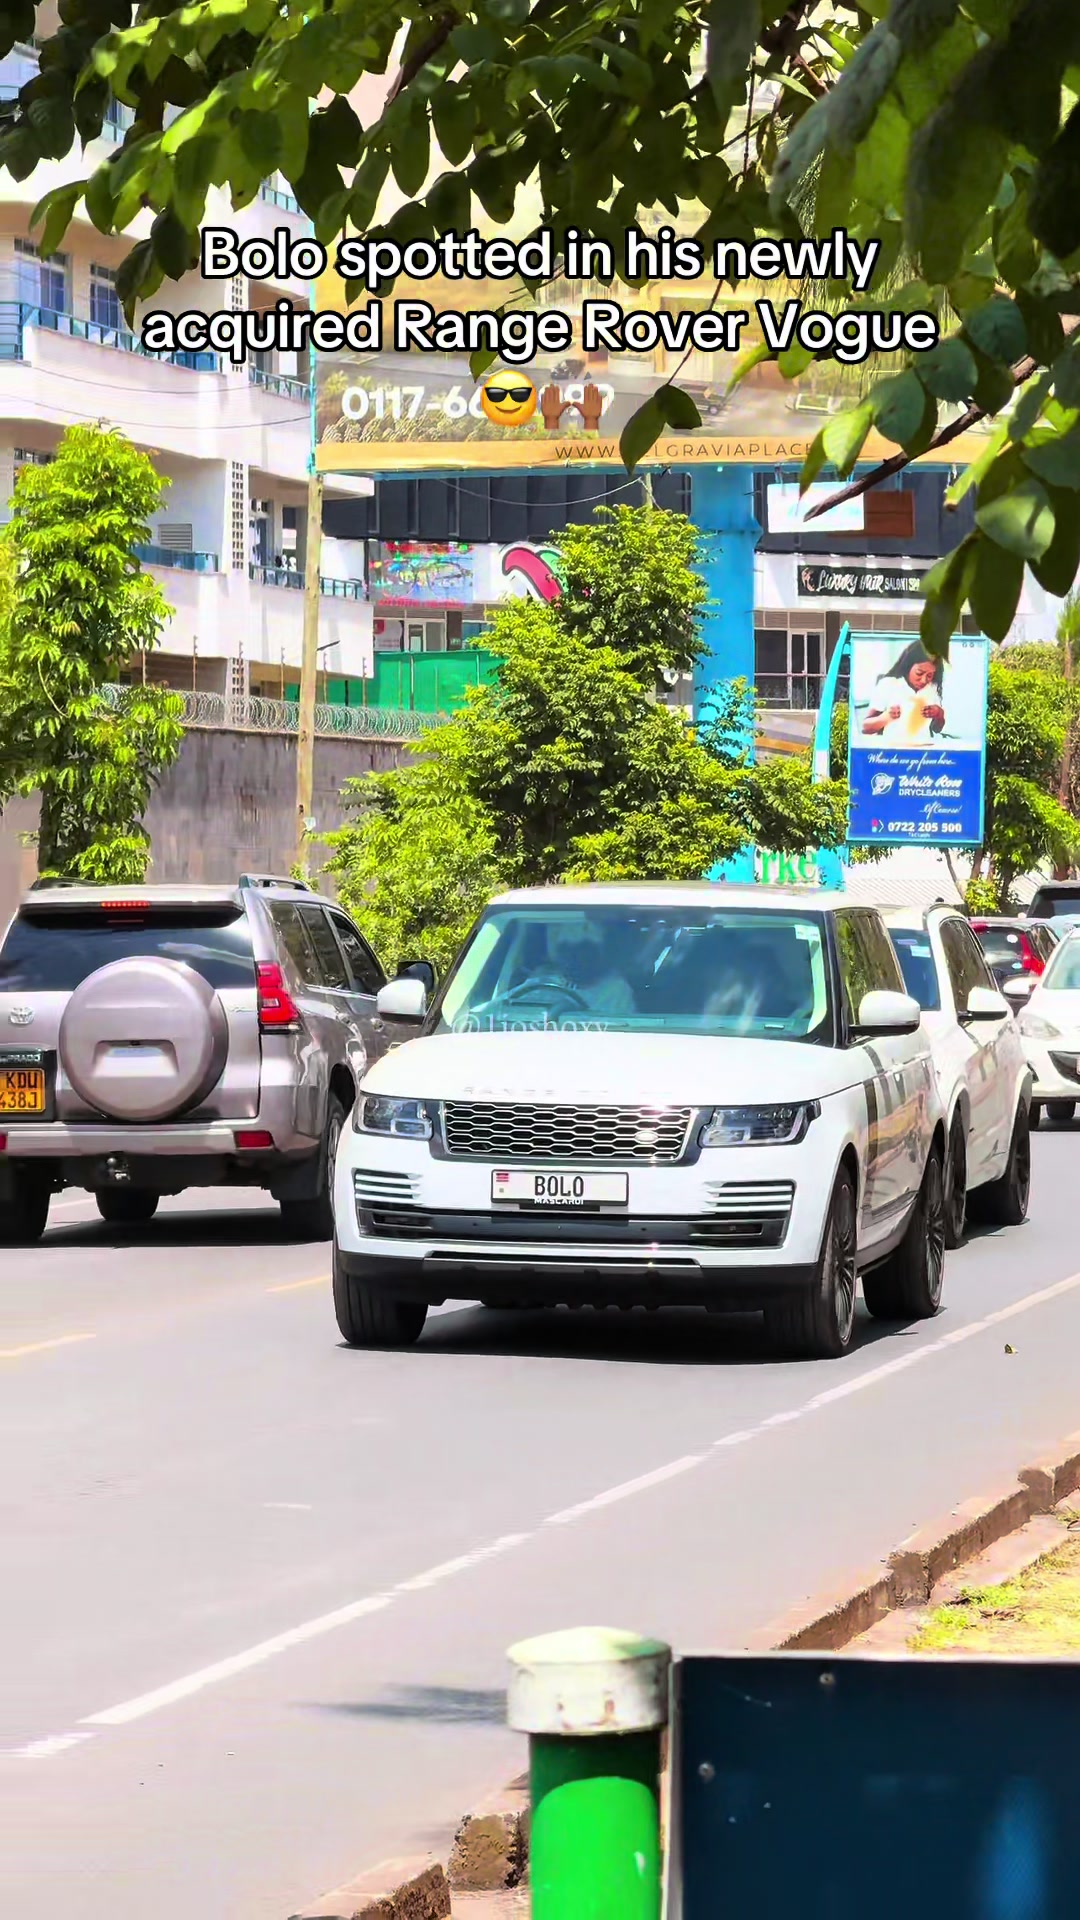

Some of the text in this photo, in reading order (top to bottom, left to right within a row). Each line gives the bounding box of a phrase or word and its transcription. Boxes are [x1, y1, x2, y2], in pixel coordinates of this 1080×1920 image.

[898, 788, 961, 798] DRYCLEANERS
[887, 821, 963, 833] 0722 205 500
[6, 1071, 38, 1089] KDU
[534, 1175, 584, 1197] BOLO
